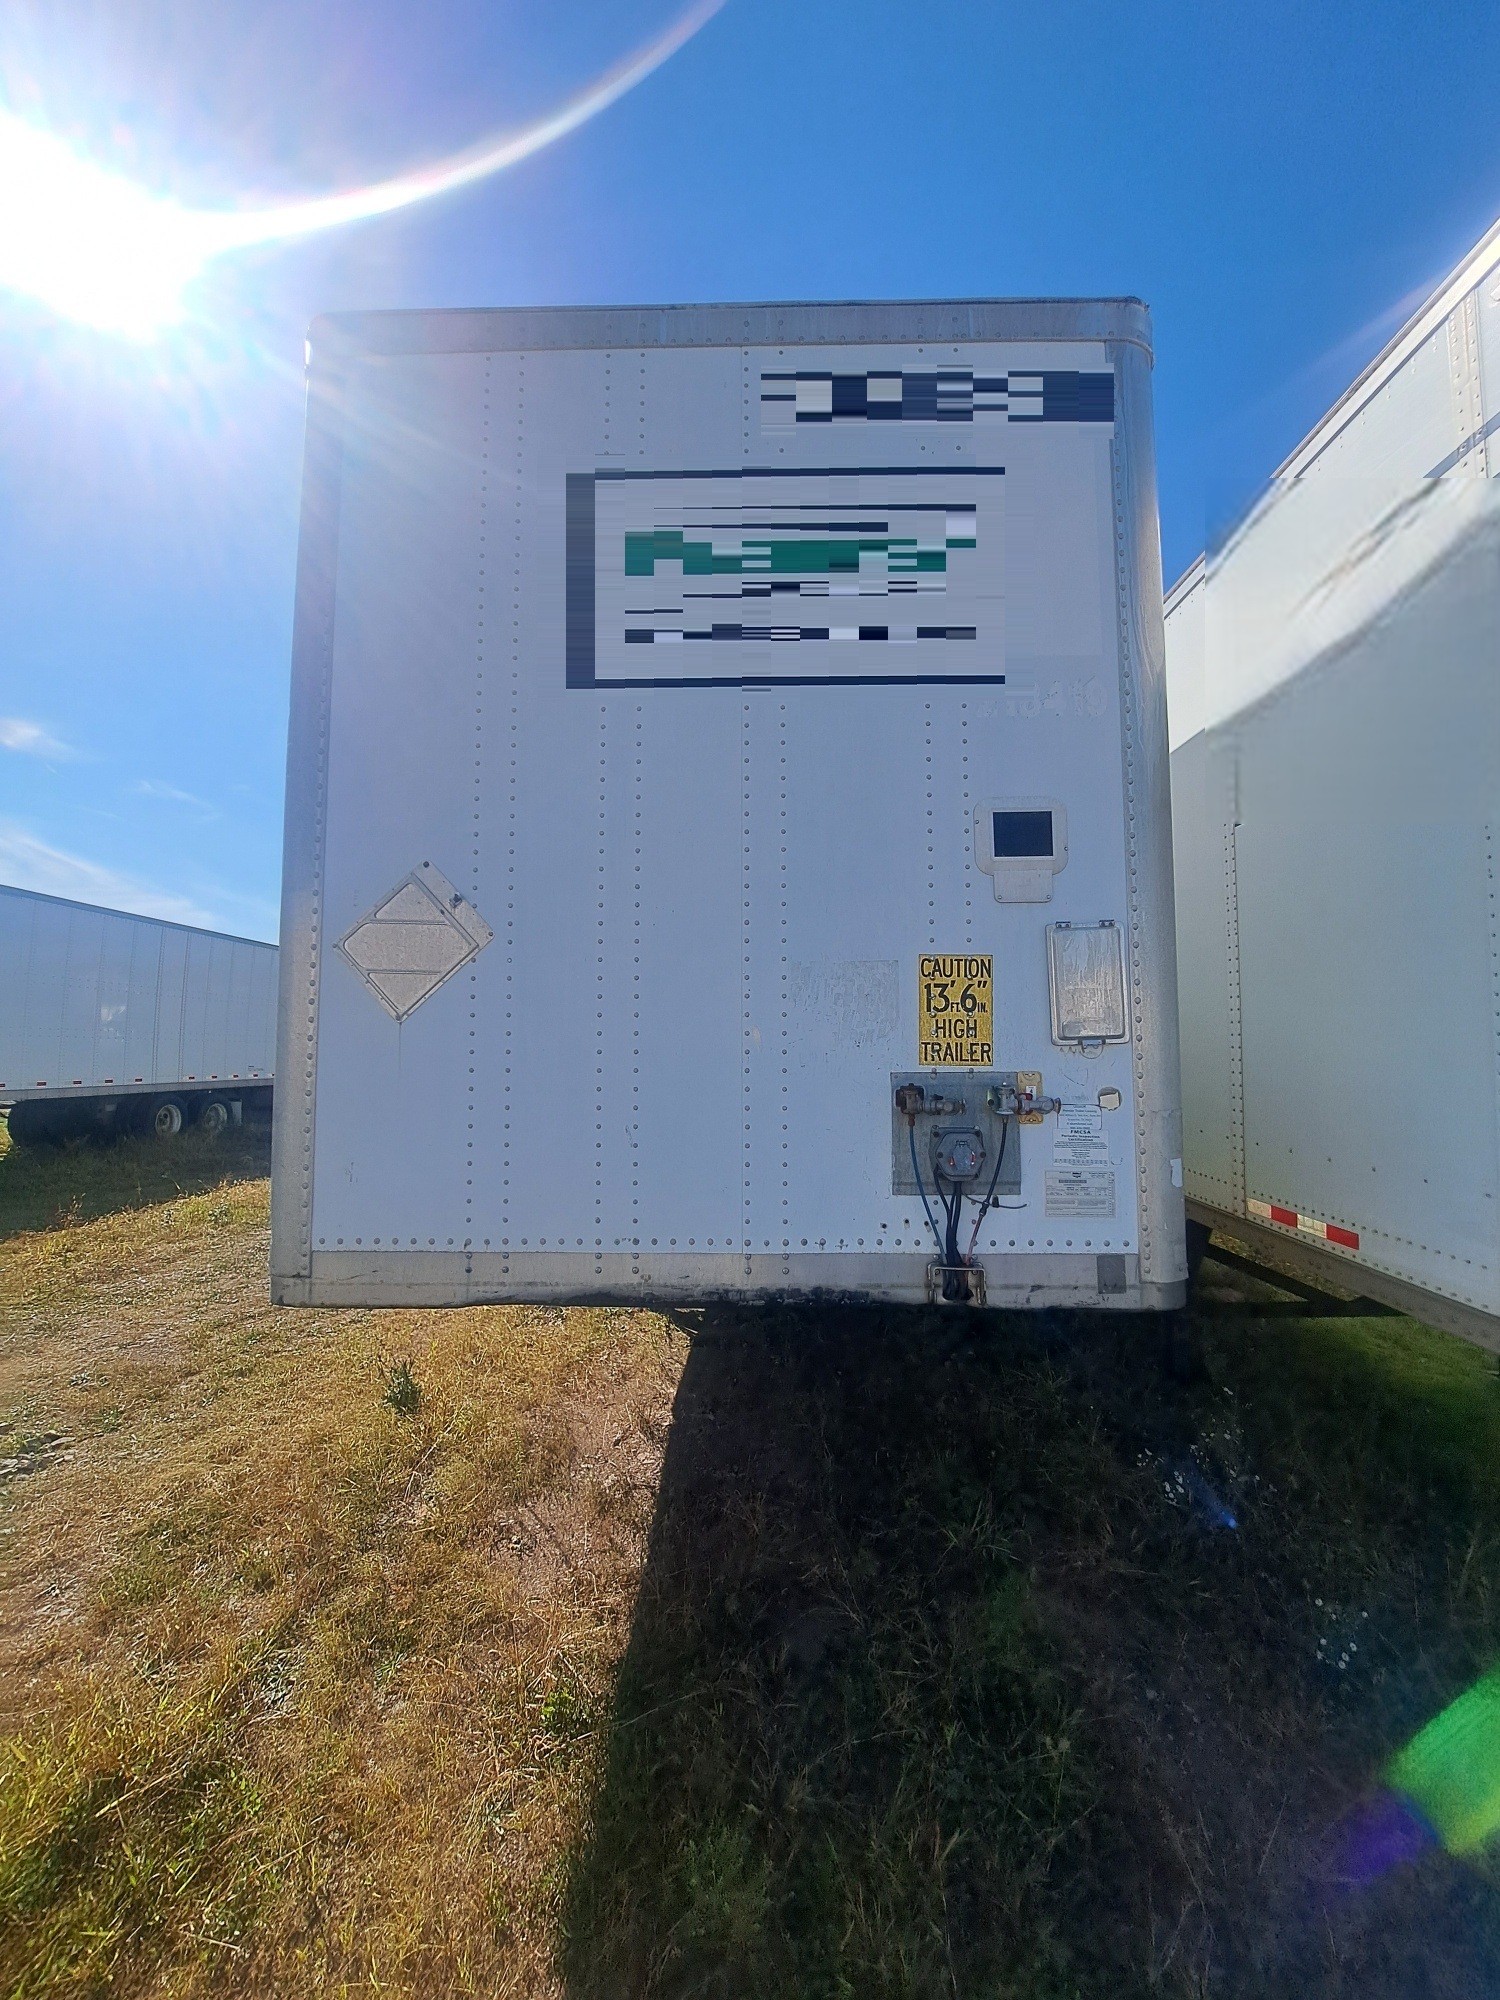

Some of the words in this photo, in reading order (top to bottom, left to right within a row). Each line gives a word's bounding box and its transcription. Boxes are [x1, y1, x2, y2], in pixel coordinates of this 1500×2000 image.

[921, 958, 991, 978] CAUTION
[935, 1019, 977, 1038] HIGH
[921, 1042, 991, 1062] TRAILER
